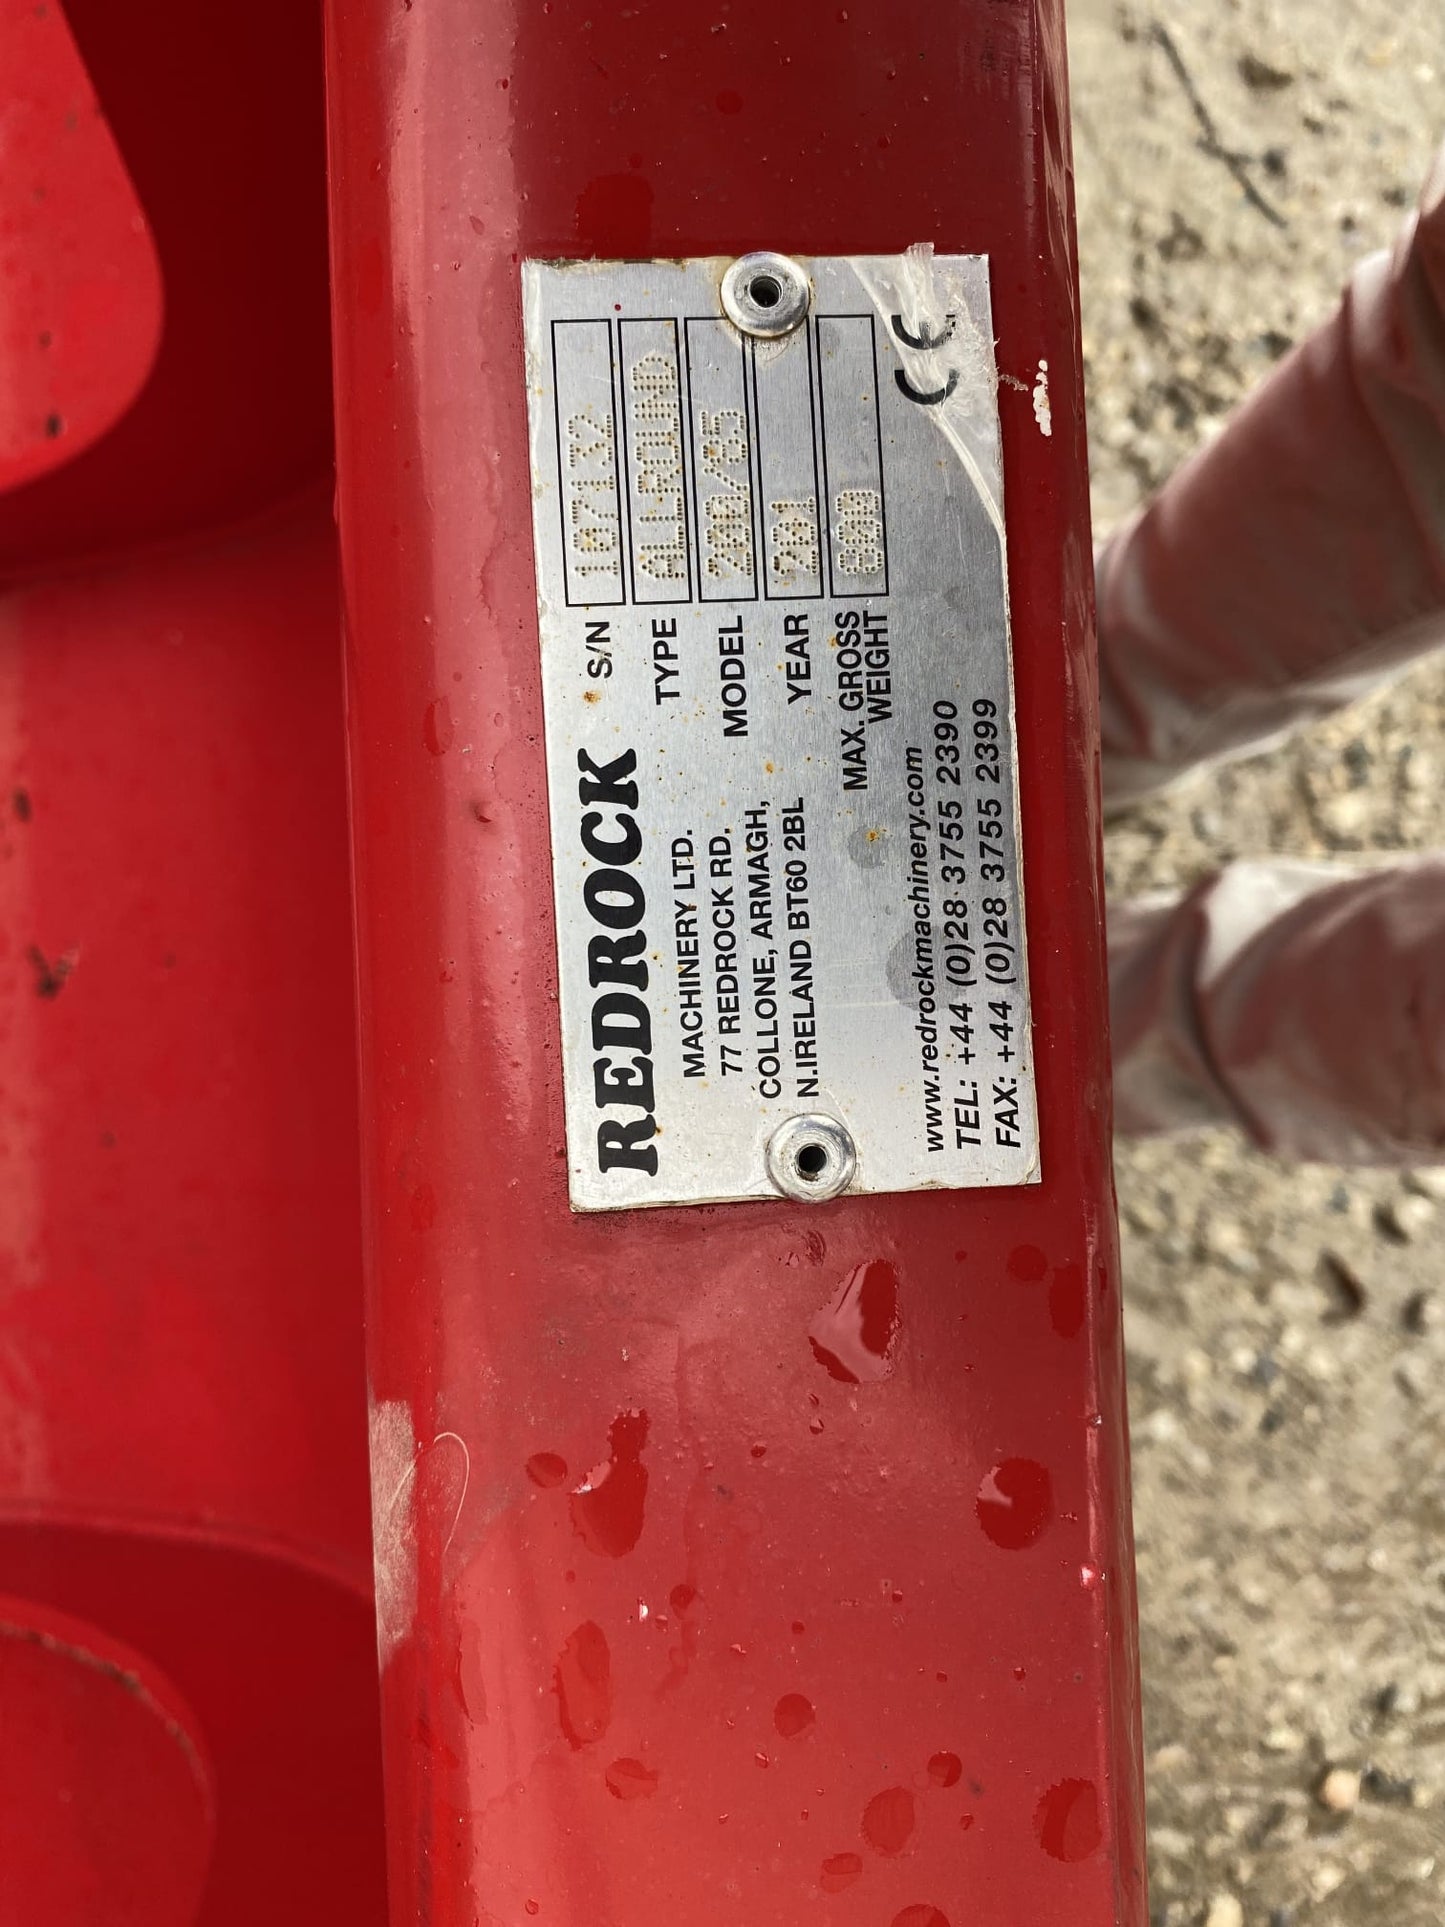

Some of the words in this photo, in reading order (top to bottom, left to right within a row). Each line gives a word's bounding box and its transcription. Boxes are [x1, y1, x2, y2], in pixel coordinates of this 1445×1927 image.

[568, 412, 618, 579] 107132
[633, 353, 685, 581] ALLROUND
[701, 409, 752, 579] 200/85
[771, 496, 818, 575] 201
[585, 620, 613, 679] S/N
[653, 617, 680, 706] TYPE
[719, 614, 749, 737] MODEL
[783, 613, 811, 704] YEAR
[836, 610, 864, 712] GROSS
[864, 610, 892, 723] WEIGHT
[840, 719, 868, 791] MAX.
[933, 700, 962, 786] 2390
[971, 697, 1000, 784] 2399
[671, 828, 696, 891] LTD.
[708, 827, 732, 877] RD.
[782, 796, 805, 852] 2BL
[937, 799, 965, 885] 3755
[976, 797, 1003, 882] 3755
[745, 799, 773, 940] ARMAGH,
[784, 859, 810, 930] BT60
[577, 747, 657, 1177] REDROCK
[710, 886, 741, 1035] REDROCK
[902, 746, 943, 1153] www.redrockmachinery.com
[942, 898, 977, 987] (0)28
[981, 896, 1016, 985] (0)28
[674, 899, 706, 1079] MACHINERY
[752, 948, 782, 1100] COLLONE,
[788, 939, 819, 1098] N.IRELAND
[989, 1000, 1014, 1063] +44
[720, 1044, 743, 1077] 77
[949, 1002, 976, 1066] +44
[953, 1078, 980, 1149] TEL:
[992, 1075, 1021, 1149] FAX:
